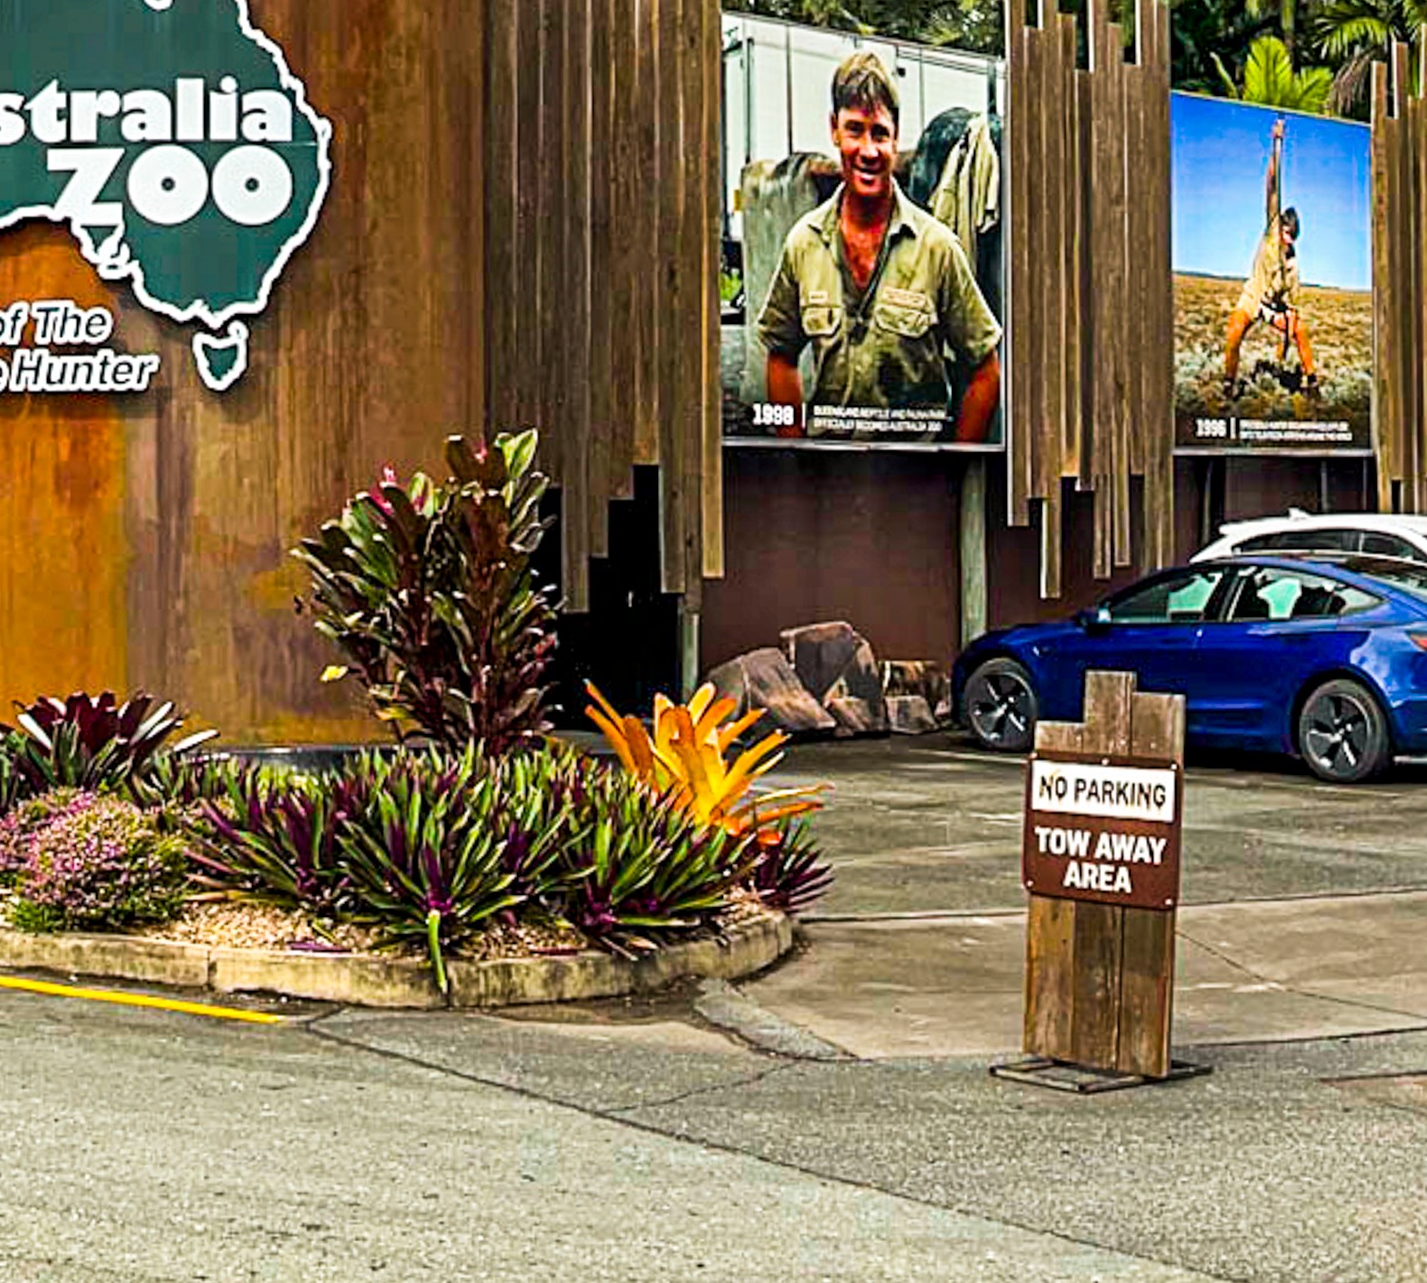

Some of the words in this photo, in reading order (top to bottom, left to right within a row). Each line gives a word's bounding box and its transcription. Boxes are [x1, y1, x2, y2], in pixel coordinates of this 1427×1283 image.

[46, 143, 294, 226] ZOO
[33, 303, 110, 341] The
[12, 351, 155, 388] Hunter
[752, 403, 794, 426] 1998
[1039, 774, 1068, 801] NO
[1074, 777, 1167, 809] PARKING
[1034, 825, 1091, 858] TOW
[1093, 830, 1167, 866] AWAY
[1063, 860, 1132, 894] AREA
